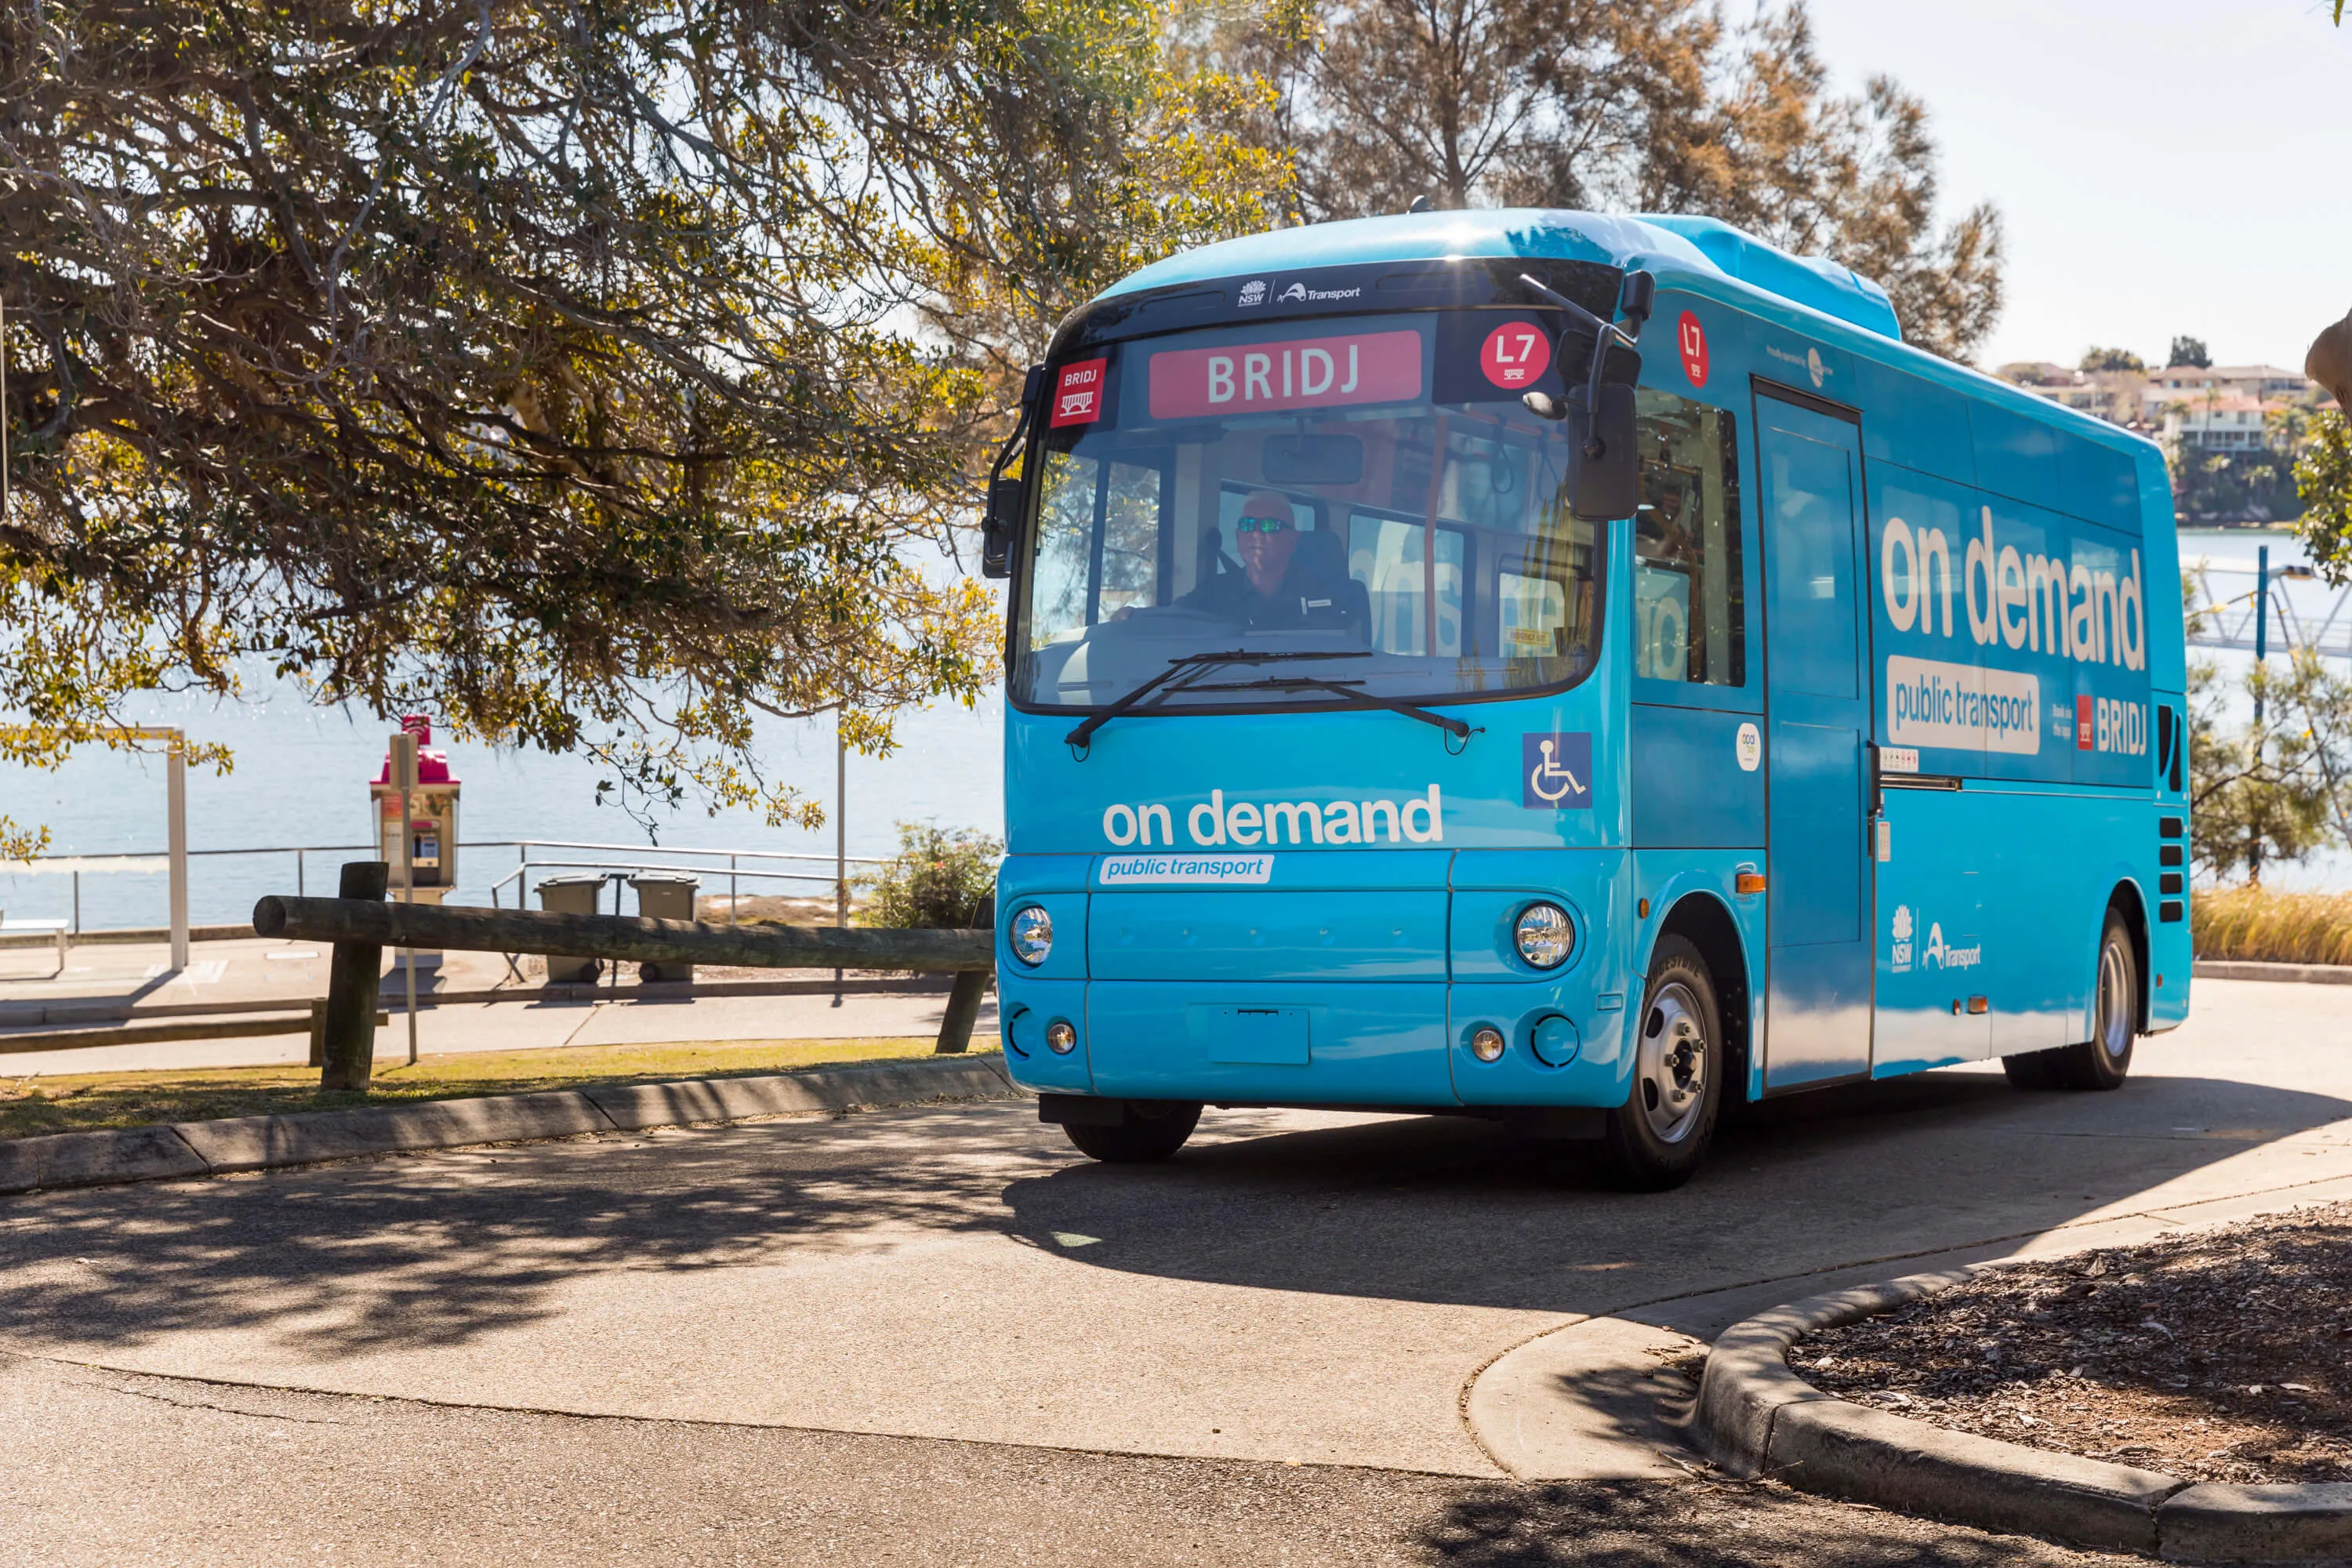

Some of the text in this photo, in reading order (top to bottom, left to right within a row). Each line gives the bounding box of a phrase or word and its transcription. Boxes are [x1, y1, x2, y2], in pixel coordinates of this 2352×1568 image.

[1239, 287, 1362, 304] NSW Transport
[1496, 334, 1535, 363] L7
[1682, 322, 1700, 358] L7
[1065, 369, 1097, 387] BRIDJ
[1207, 343, 1359, 404] BRIDJ
[1882, 505, 2146, 671] on demand
[1896, 673, 2033, 740] public transport
[2097, 696, 2147, 756] BRIDJ
[1102, 783, 1443, 846] on demand
[1107, 858, 1265, 880] public transport
[1892, 942, 1981, 971] NSW Transport
